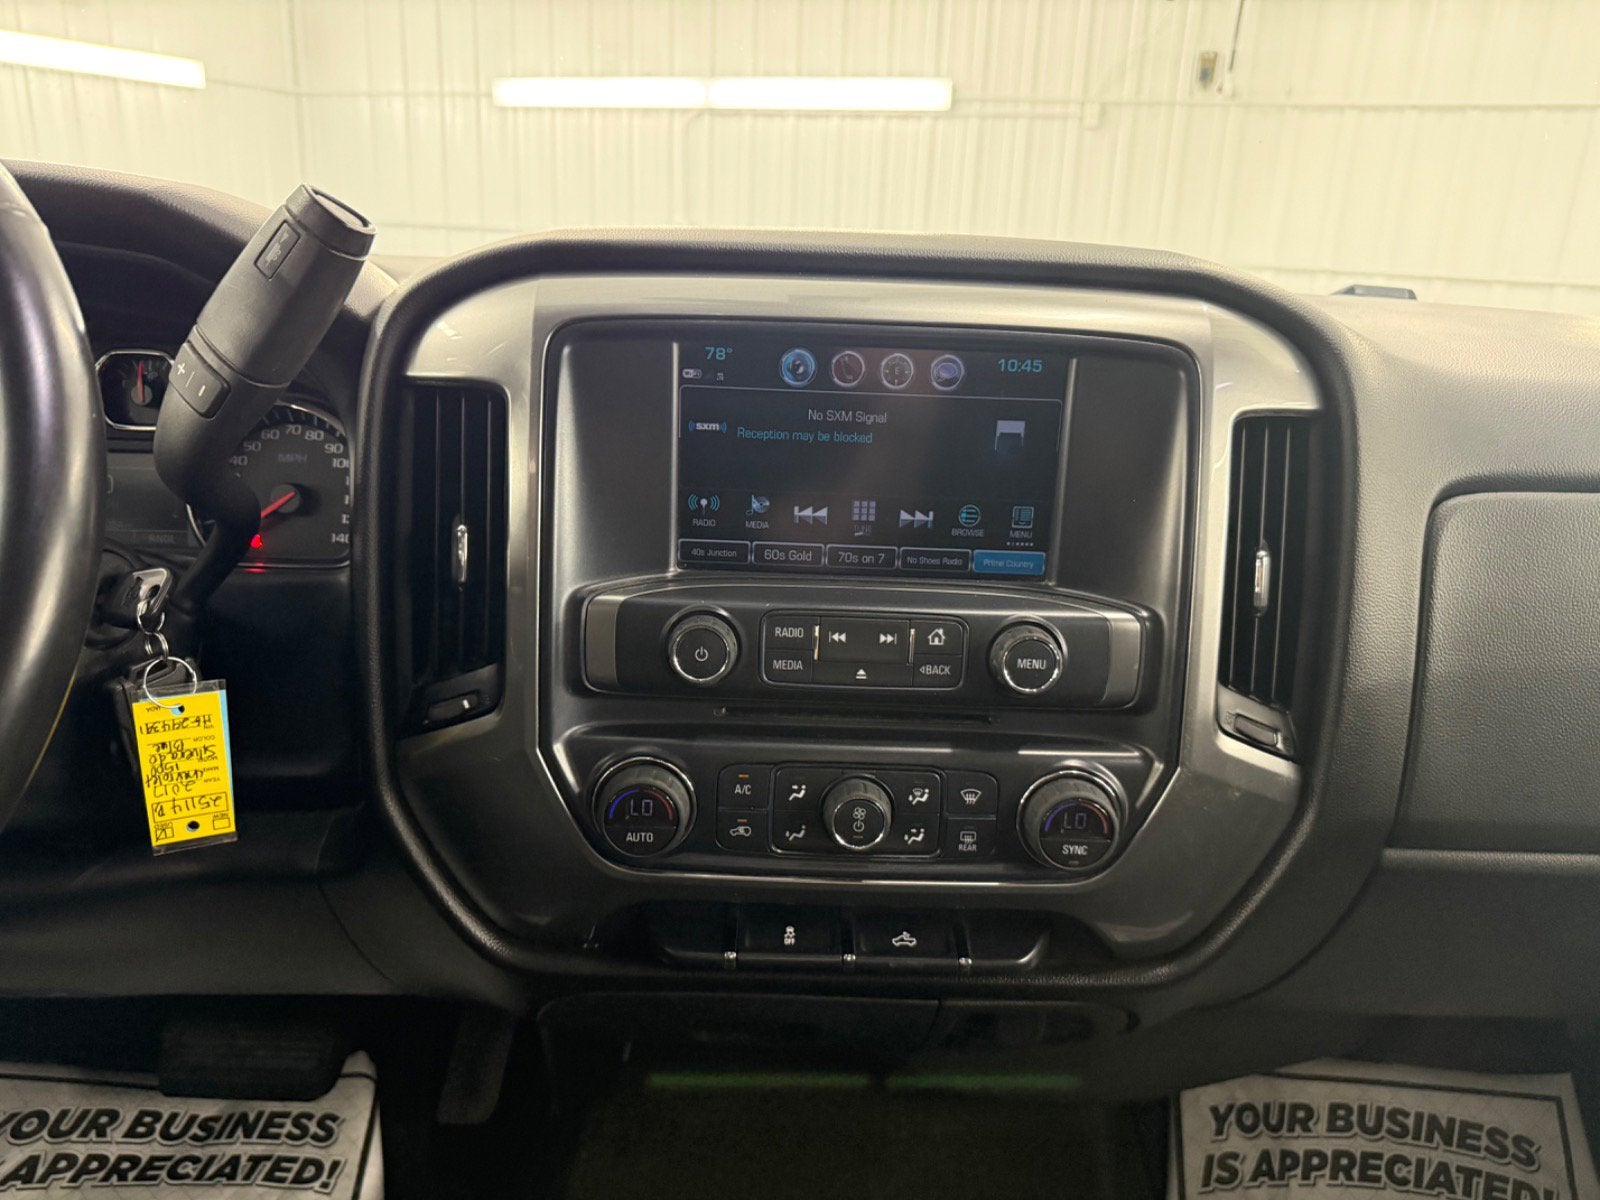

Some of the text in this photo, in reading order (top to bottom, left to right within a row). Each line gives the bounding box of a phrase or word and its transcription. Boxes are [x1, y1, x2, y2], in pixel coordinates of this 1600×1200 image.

[704, 346, 733, 360] 78°
[998, 358, 1043, 373] 10:45
[808, 409, 887, 425] No SXM Signal
[285, 424, 301, 435] 70
[696, 421, 720, 431] sxm
[261, 429, 280, 440] 60
[305, 429, 324, 440] 80
[737, 426, 872, 444] Reception may be blocked
[243, 441, 261, 451] 50
[324, 443, 344, 454] 90
[229, 455, 248, 466] 40
[692, 518, 716, 527] RADIO
[745, 520, 769, 529] MEDIA
[951, 528, 984, 537] BROWSE
[1010, 530, 1032, 538] MENU
[706, 549, 737, 557] Junction
[763, 549, 812, 562] 60s Gold
[838, 552, 885, 564] 70s on 7
[907, 556, 963, 566] No Shoes Radio
[1006, 559, 1034, 569] Country
[774, 626, 804, 638] RADIO
[773, 660, 803, 671] MEDIA
[1017, 658, 1047, 670] MENU
[925, 665, 951, 675] BACK
[153, 780, 196, 798] 2017
[734, 784, 751, 795] A/C
[630, 799, 653, 816] LO
[1063, 812, 1087, 829] LO
[626, 832, 654, 843] AUTO
[958, 843, 977, 851] REAR
[1062, 844, 1088, 856] SYNC
[122, 1109, 340, 1142] BUSINESS
[1209, 1102, 1537, 1168] YOUR BUSINESS
[0, 1153, 342, 1189] APPRECIATED!
[1202, 1150, 1241, 1189] IS
